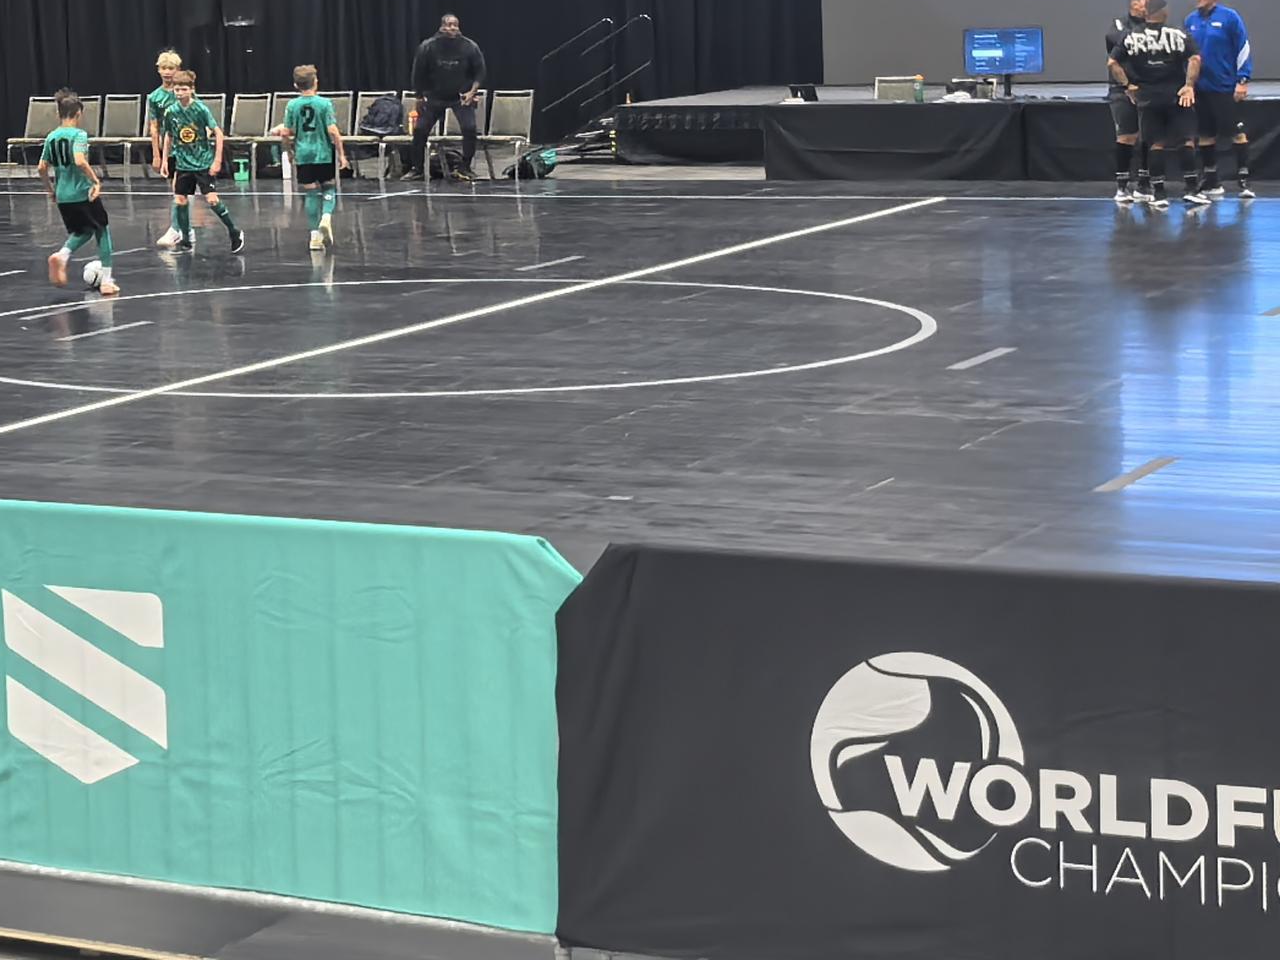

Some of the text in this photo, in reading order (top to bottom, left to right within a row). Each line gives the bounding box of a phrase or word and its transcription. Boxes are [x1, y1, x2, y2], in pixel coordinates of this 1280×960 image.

[301, 105, 316, 133] 2
[50, 138, 72, 168] 10
[884, 755, 1280, 848] WORLDF
[1010, 838, 1280, 912] CHAMPI
